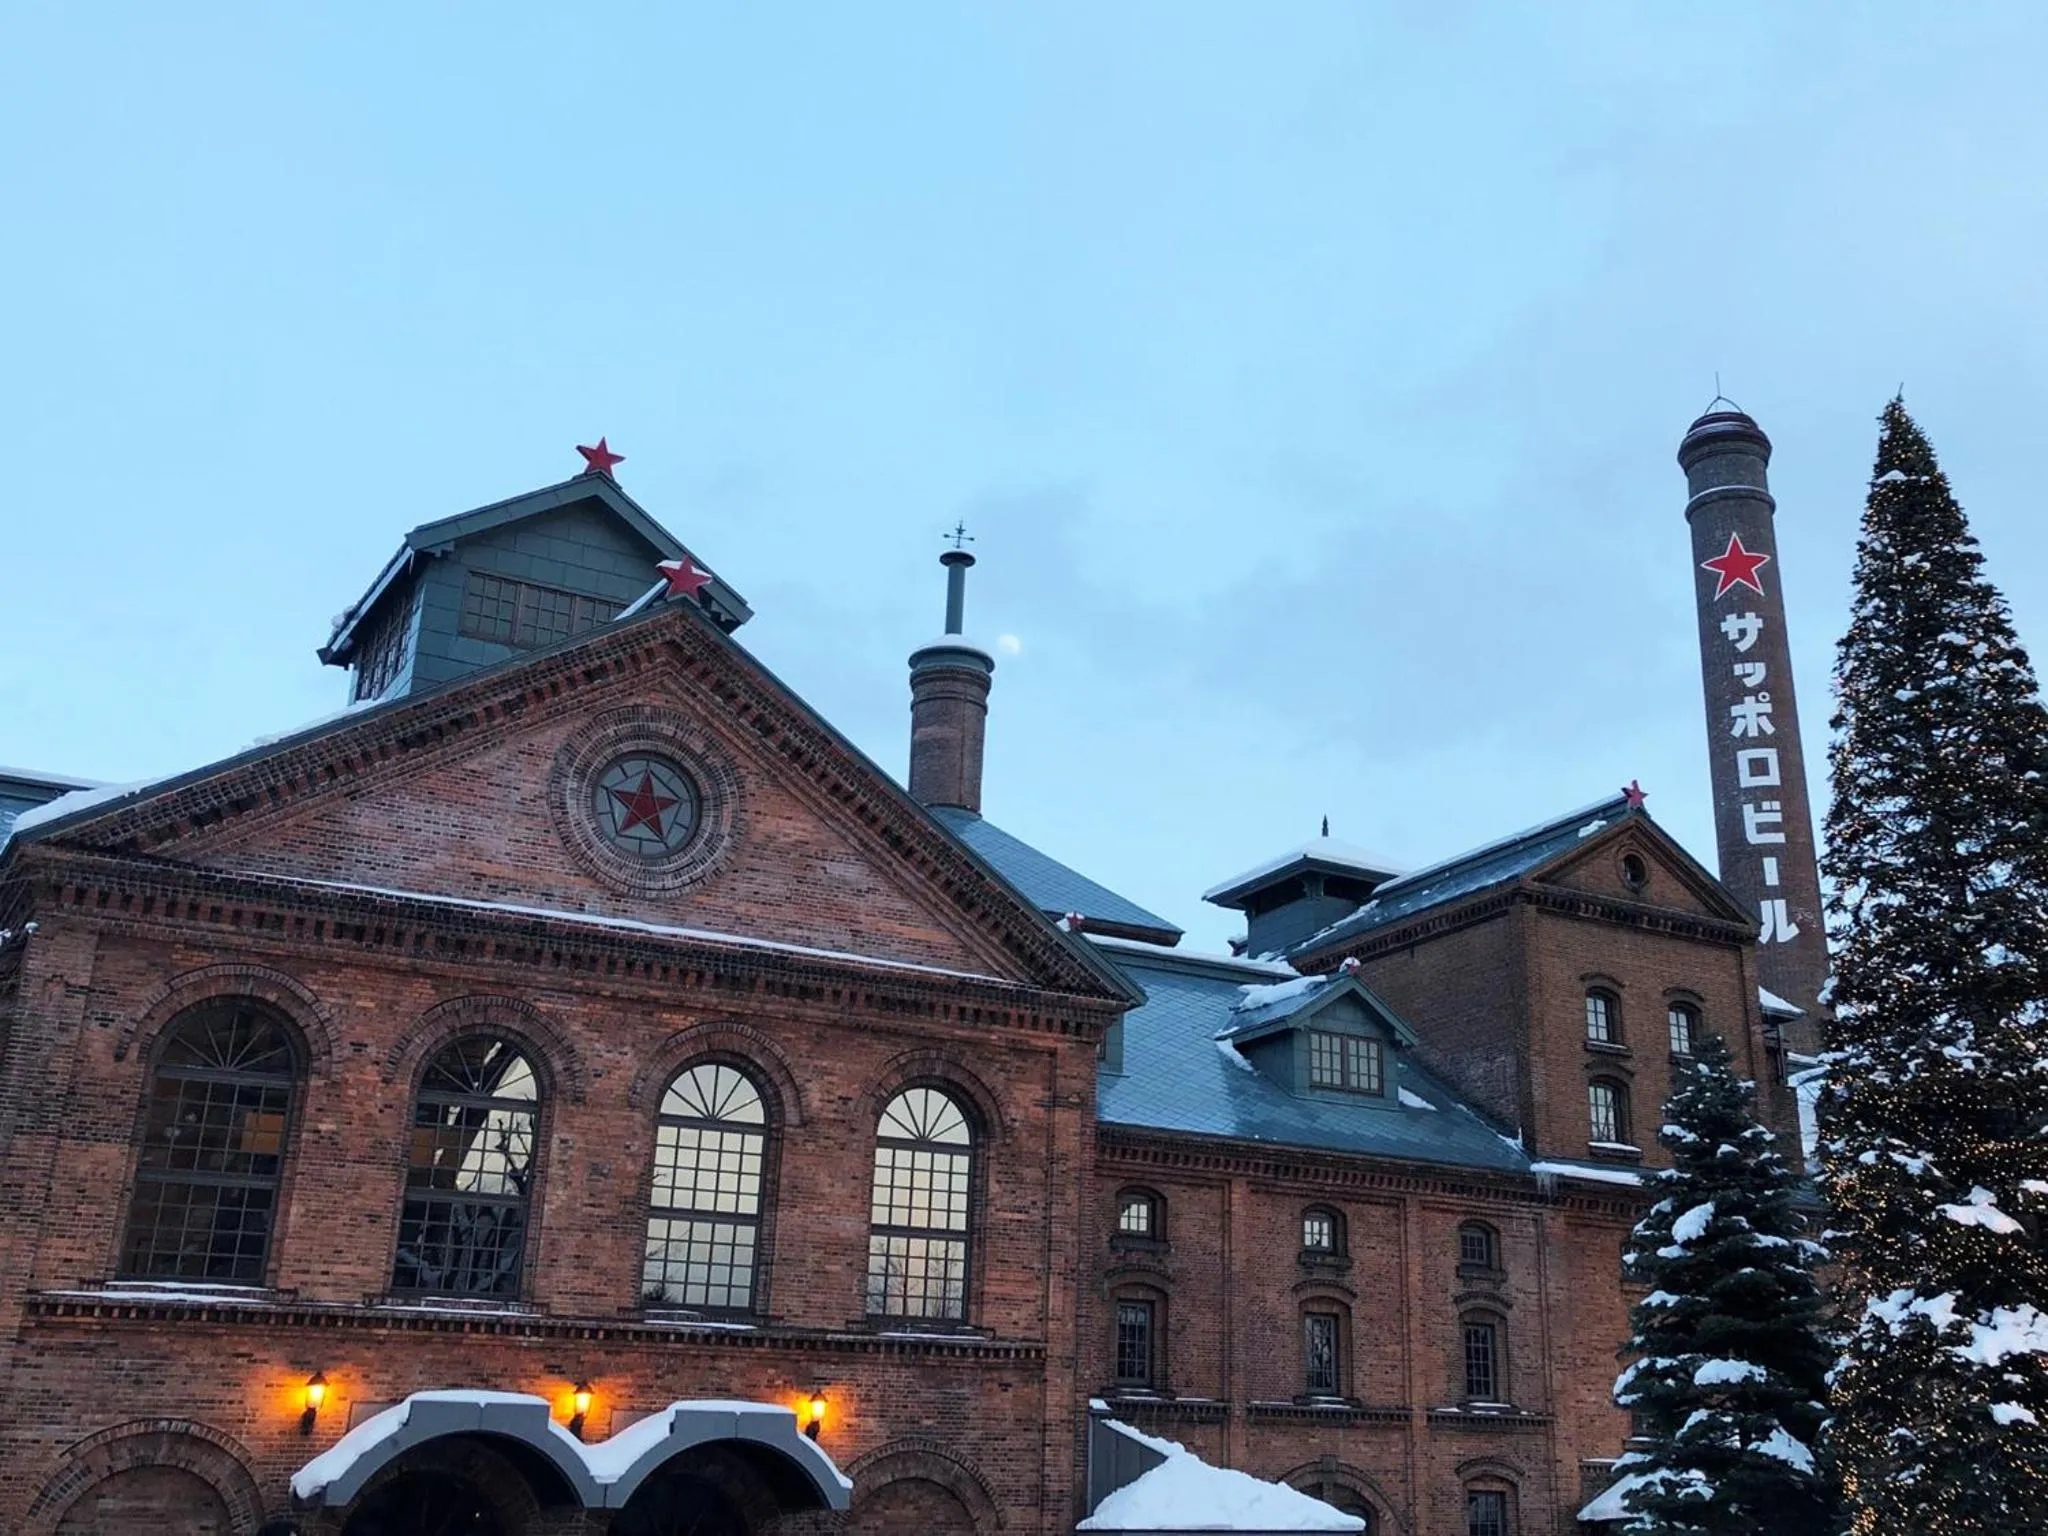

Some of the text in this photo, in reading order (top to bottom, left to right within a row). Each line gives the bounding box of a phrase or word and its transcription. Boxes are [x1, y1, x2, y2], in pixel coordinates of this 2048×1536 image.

[1720, 612, 1799, 944] サッポロビール
